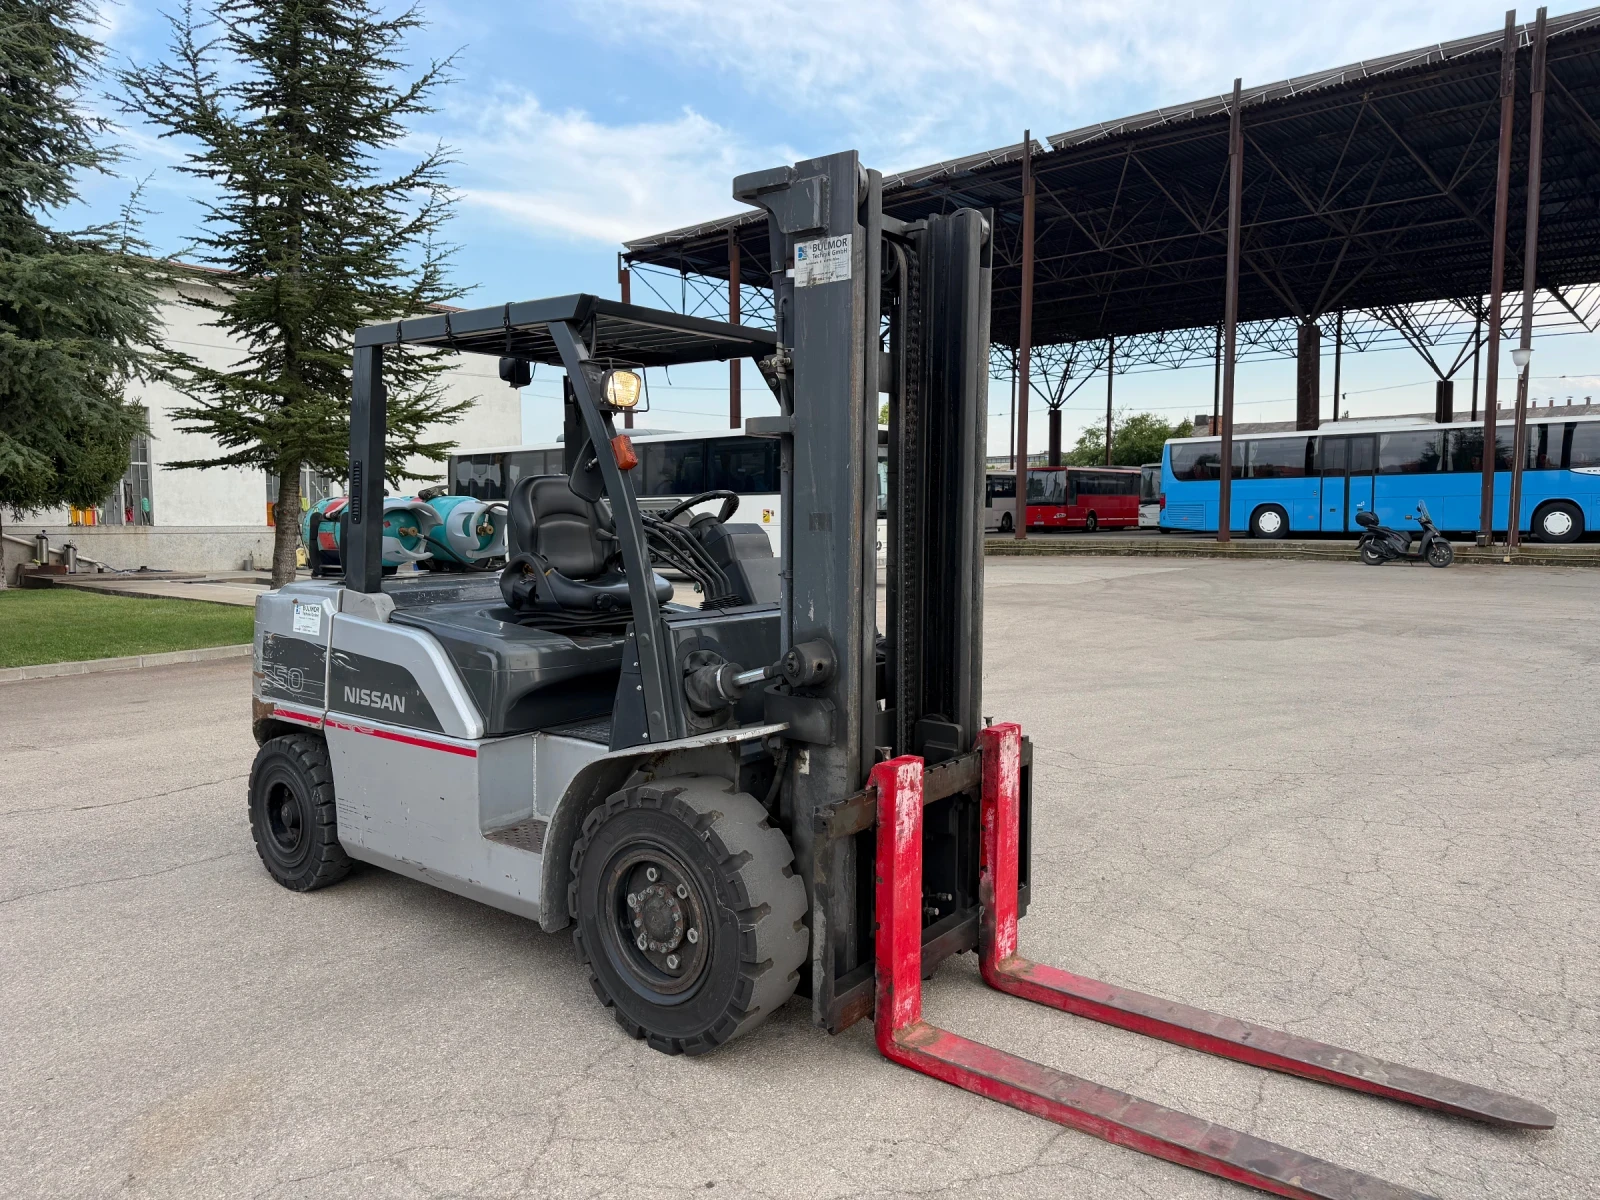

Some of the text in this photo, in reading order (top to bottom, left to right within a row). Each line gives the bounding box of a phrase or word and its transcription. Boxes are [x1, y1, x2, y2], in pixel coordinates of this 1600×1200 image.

[812, 238, 848, 253] BULMOR
[832, 247, 848, 256] GmbH
[344, 685, 406, 714] NISSAN
